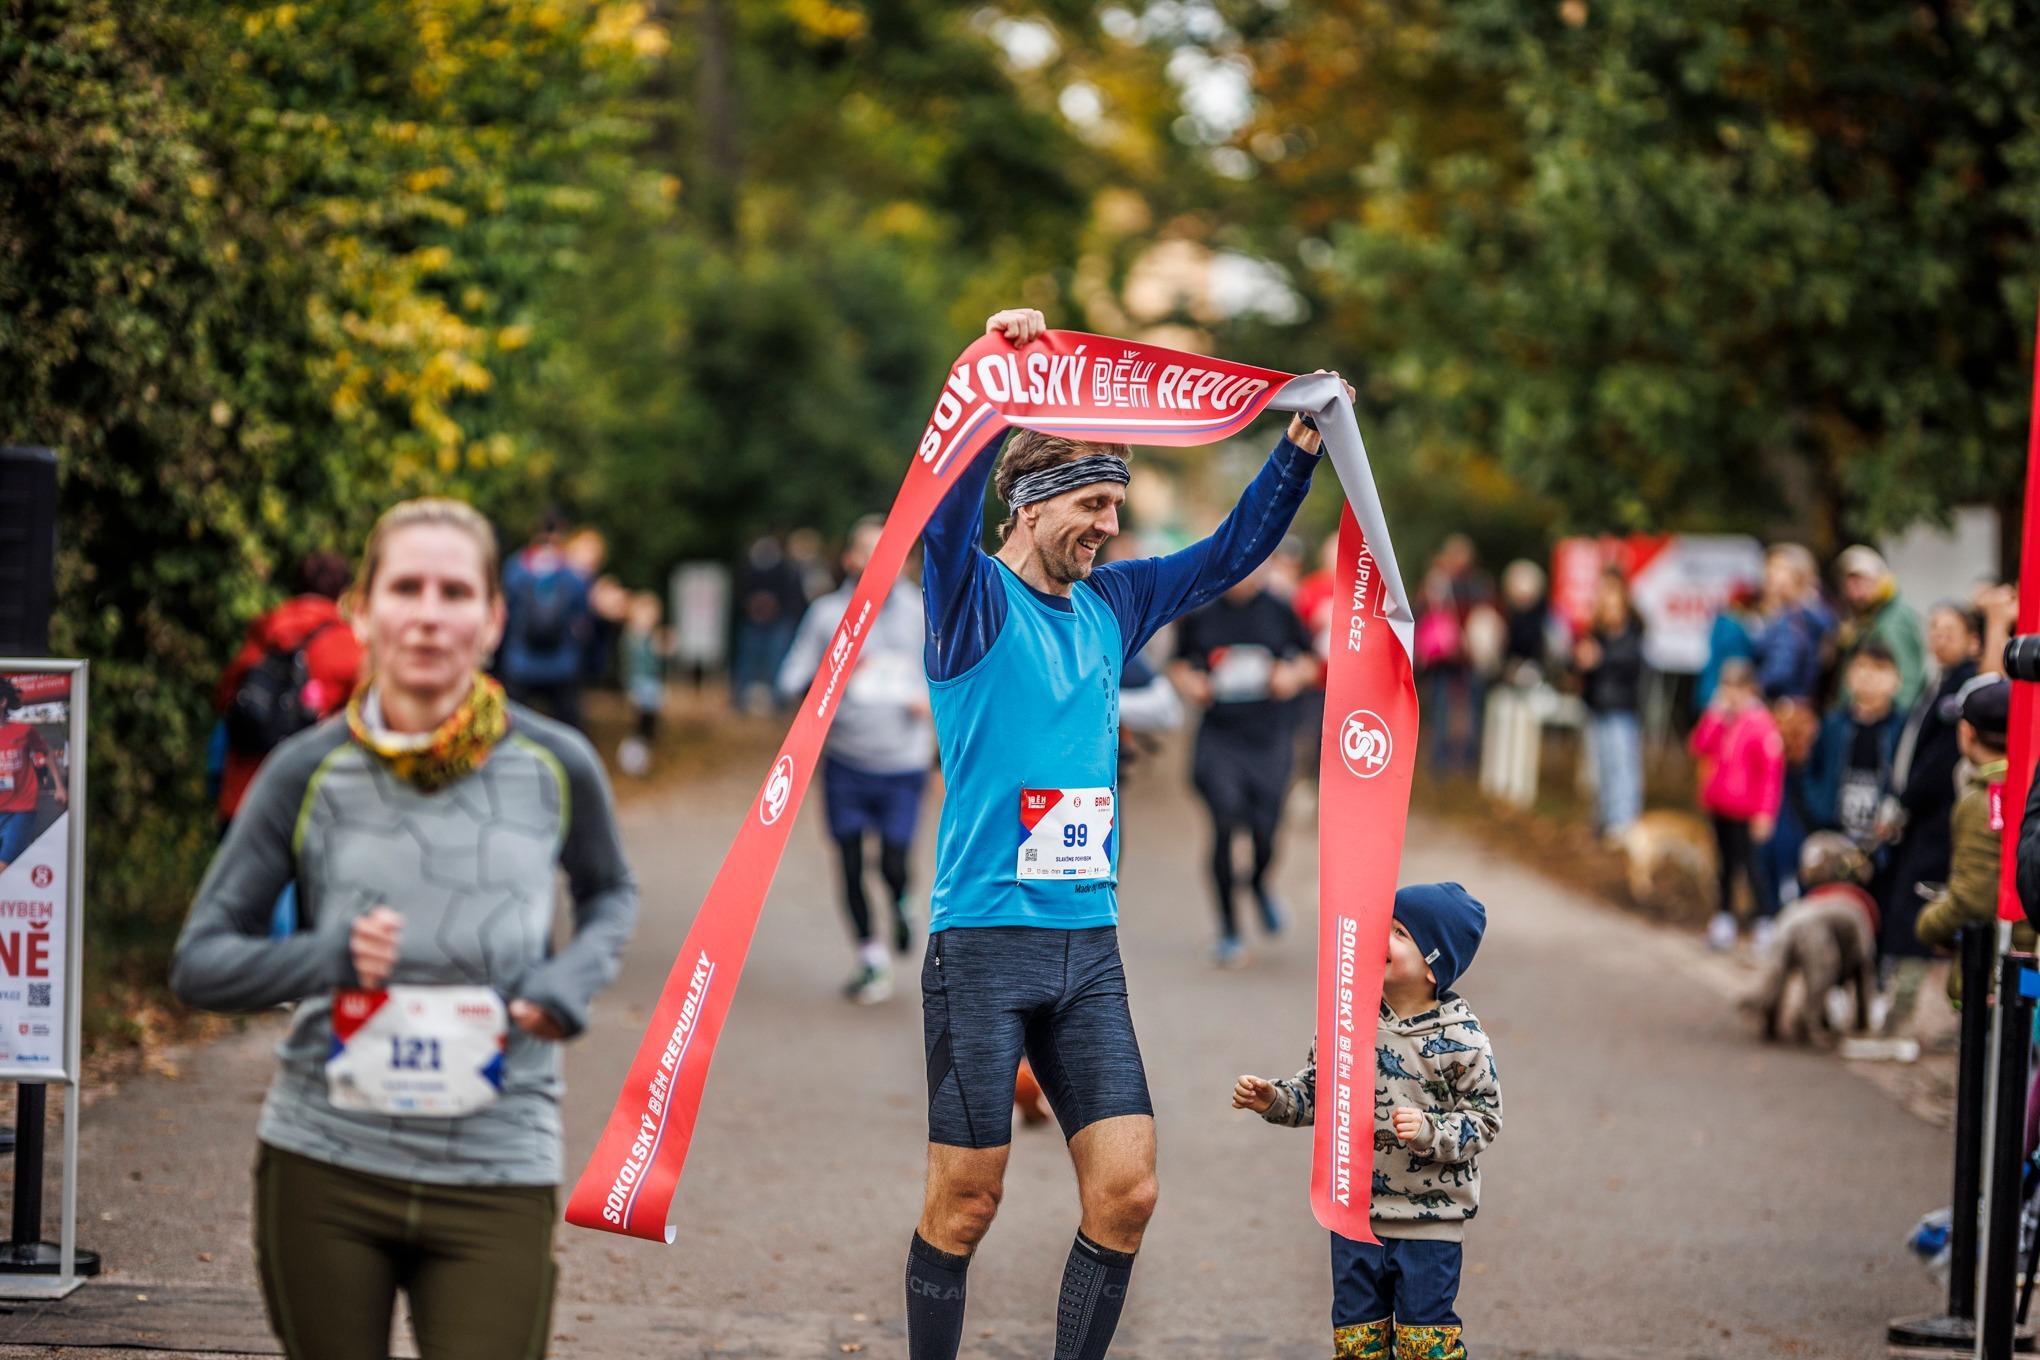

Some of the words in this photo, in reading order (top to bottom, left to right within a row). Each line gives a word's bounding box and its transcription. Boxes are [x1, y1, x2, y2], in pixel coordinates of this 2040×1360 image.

[919, 345, 1087, 463] SOKOLSKÝ
[1092, 350, 1156, 408] BĚH
[1348, 615, 1365, 652] ČEZ
[1095, 797, 1110, 807] BRNO
[1063, 824, 1088, 847] 99
[1340, 918, 1357, 1032] SOKOLSKÝ
[391, 1036, 440, 1069] 121
[1339, 1035, 1353, 1080] BĚH
[602, 1113, 657, 1224] SOKOLSKÝ
[648, 1069, 669, 1117] BĚH
[661, 950, 711, 1072] REPUBLIKY
[1337, 1084, 1351, 1207] REPUBLIKY
